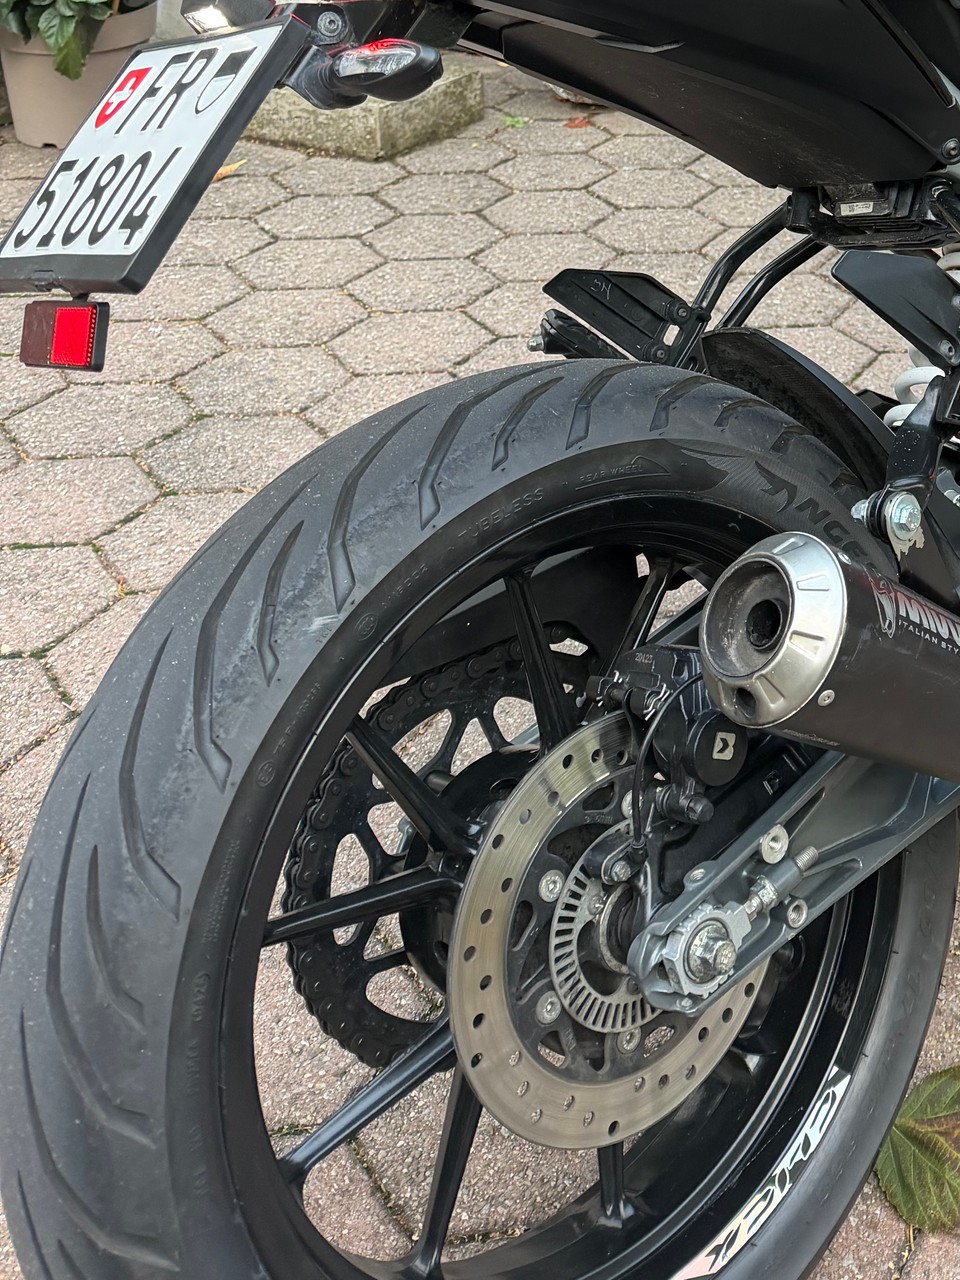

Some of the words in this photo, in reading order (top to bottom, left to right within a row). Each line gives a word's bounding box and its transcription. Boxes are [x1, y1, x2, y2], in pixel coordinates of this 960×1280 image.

[114, 48, 218, 136] FR
[12, 146, 183, 252] 51804
[458, 487, 543, 537] TUBELESS
[899, 619, 939, 645] ITALIAN
